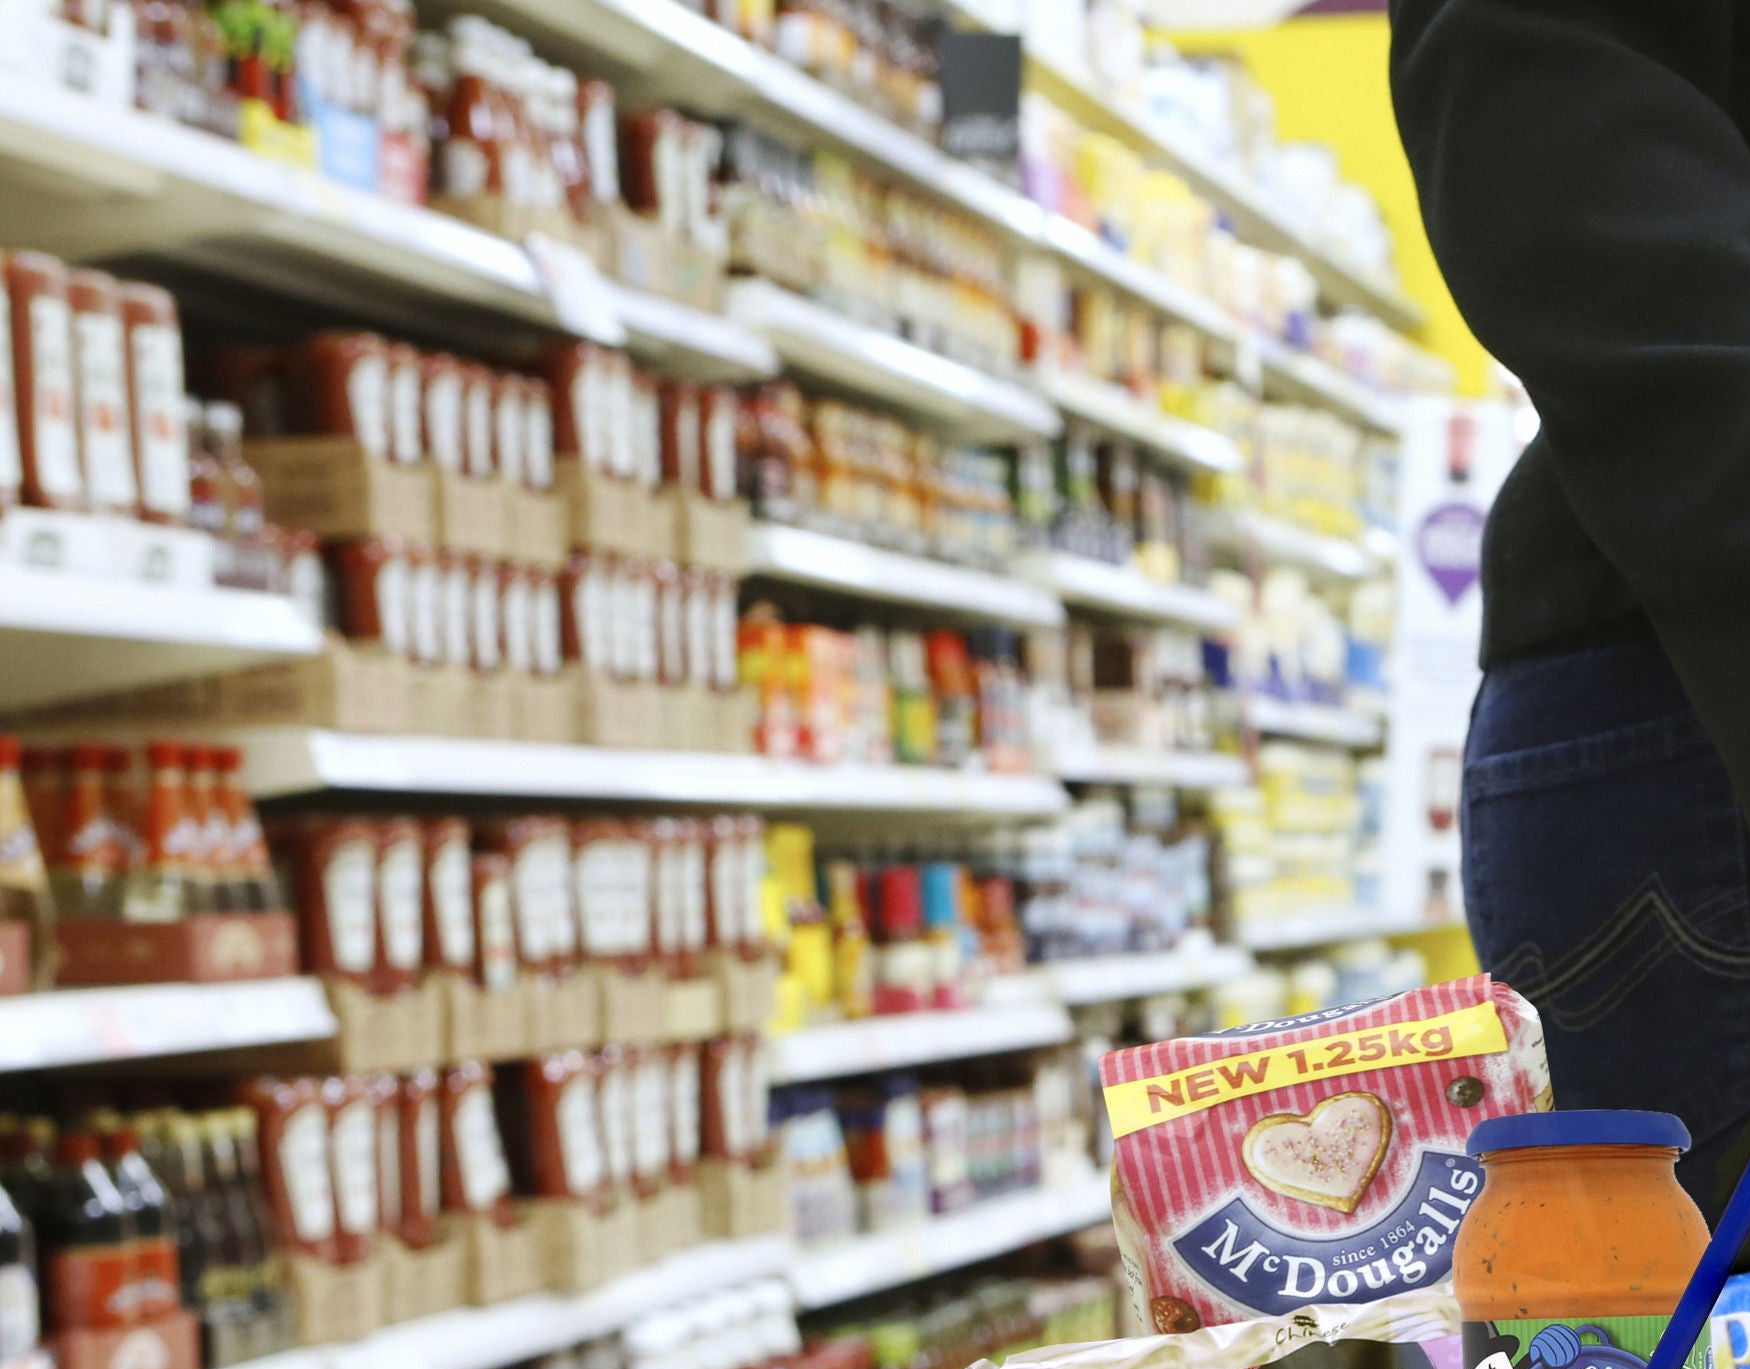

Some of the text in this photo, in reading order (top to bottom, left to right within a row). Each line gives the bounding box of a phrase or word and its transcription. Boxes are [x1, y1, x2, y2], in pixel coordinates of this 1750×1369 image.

[1145, 1025, 1454, 1115] NEW 1.25kg
[1200, 1168, 1480, 1298] McDougalls
[1332, 1219, 1416, 1266] since 1864
